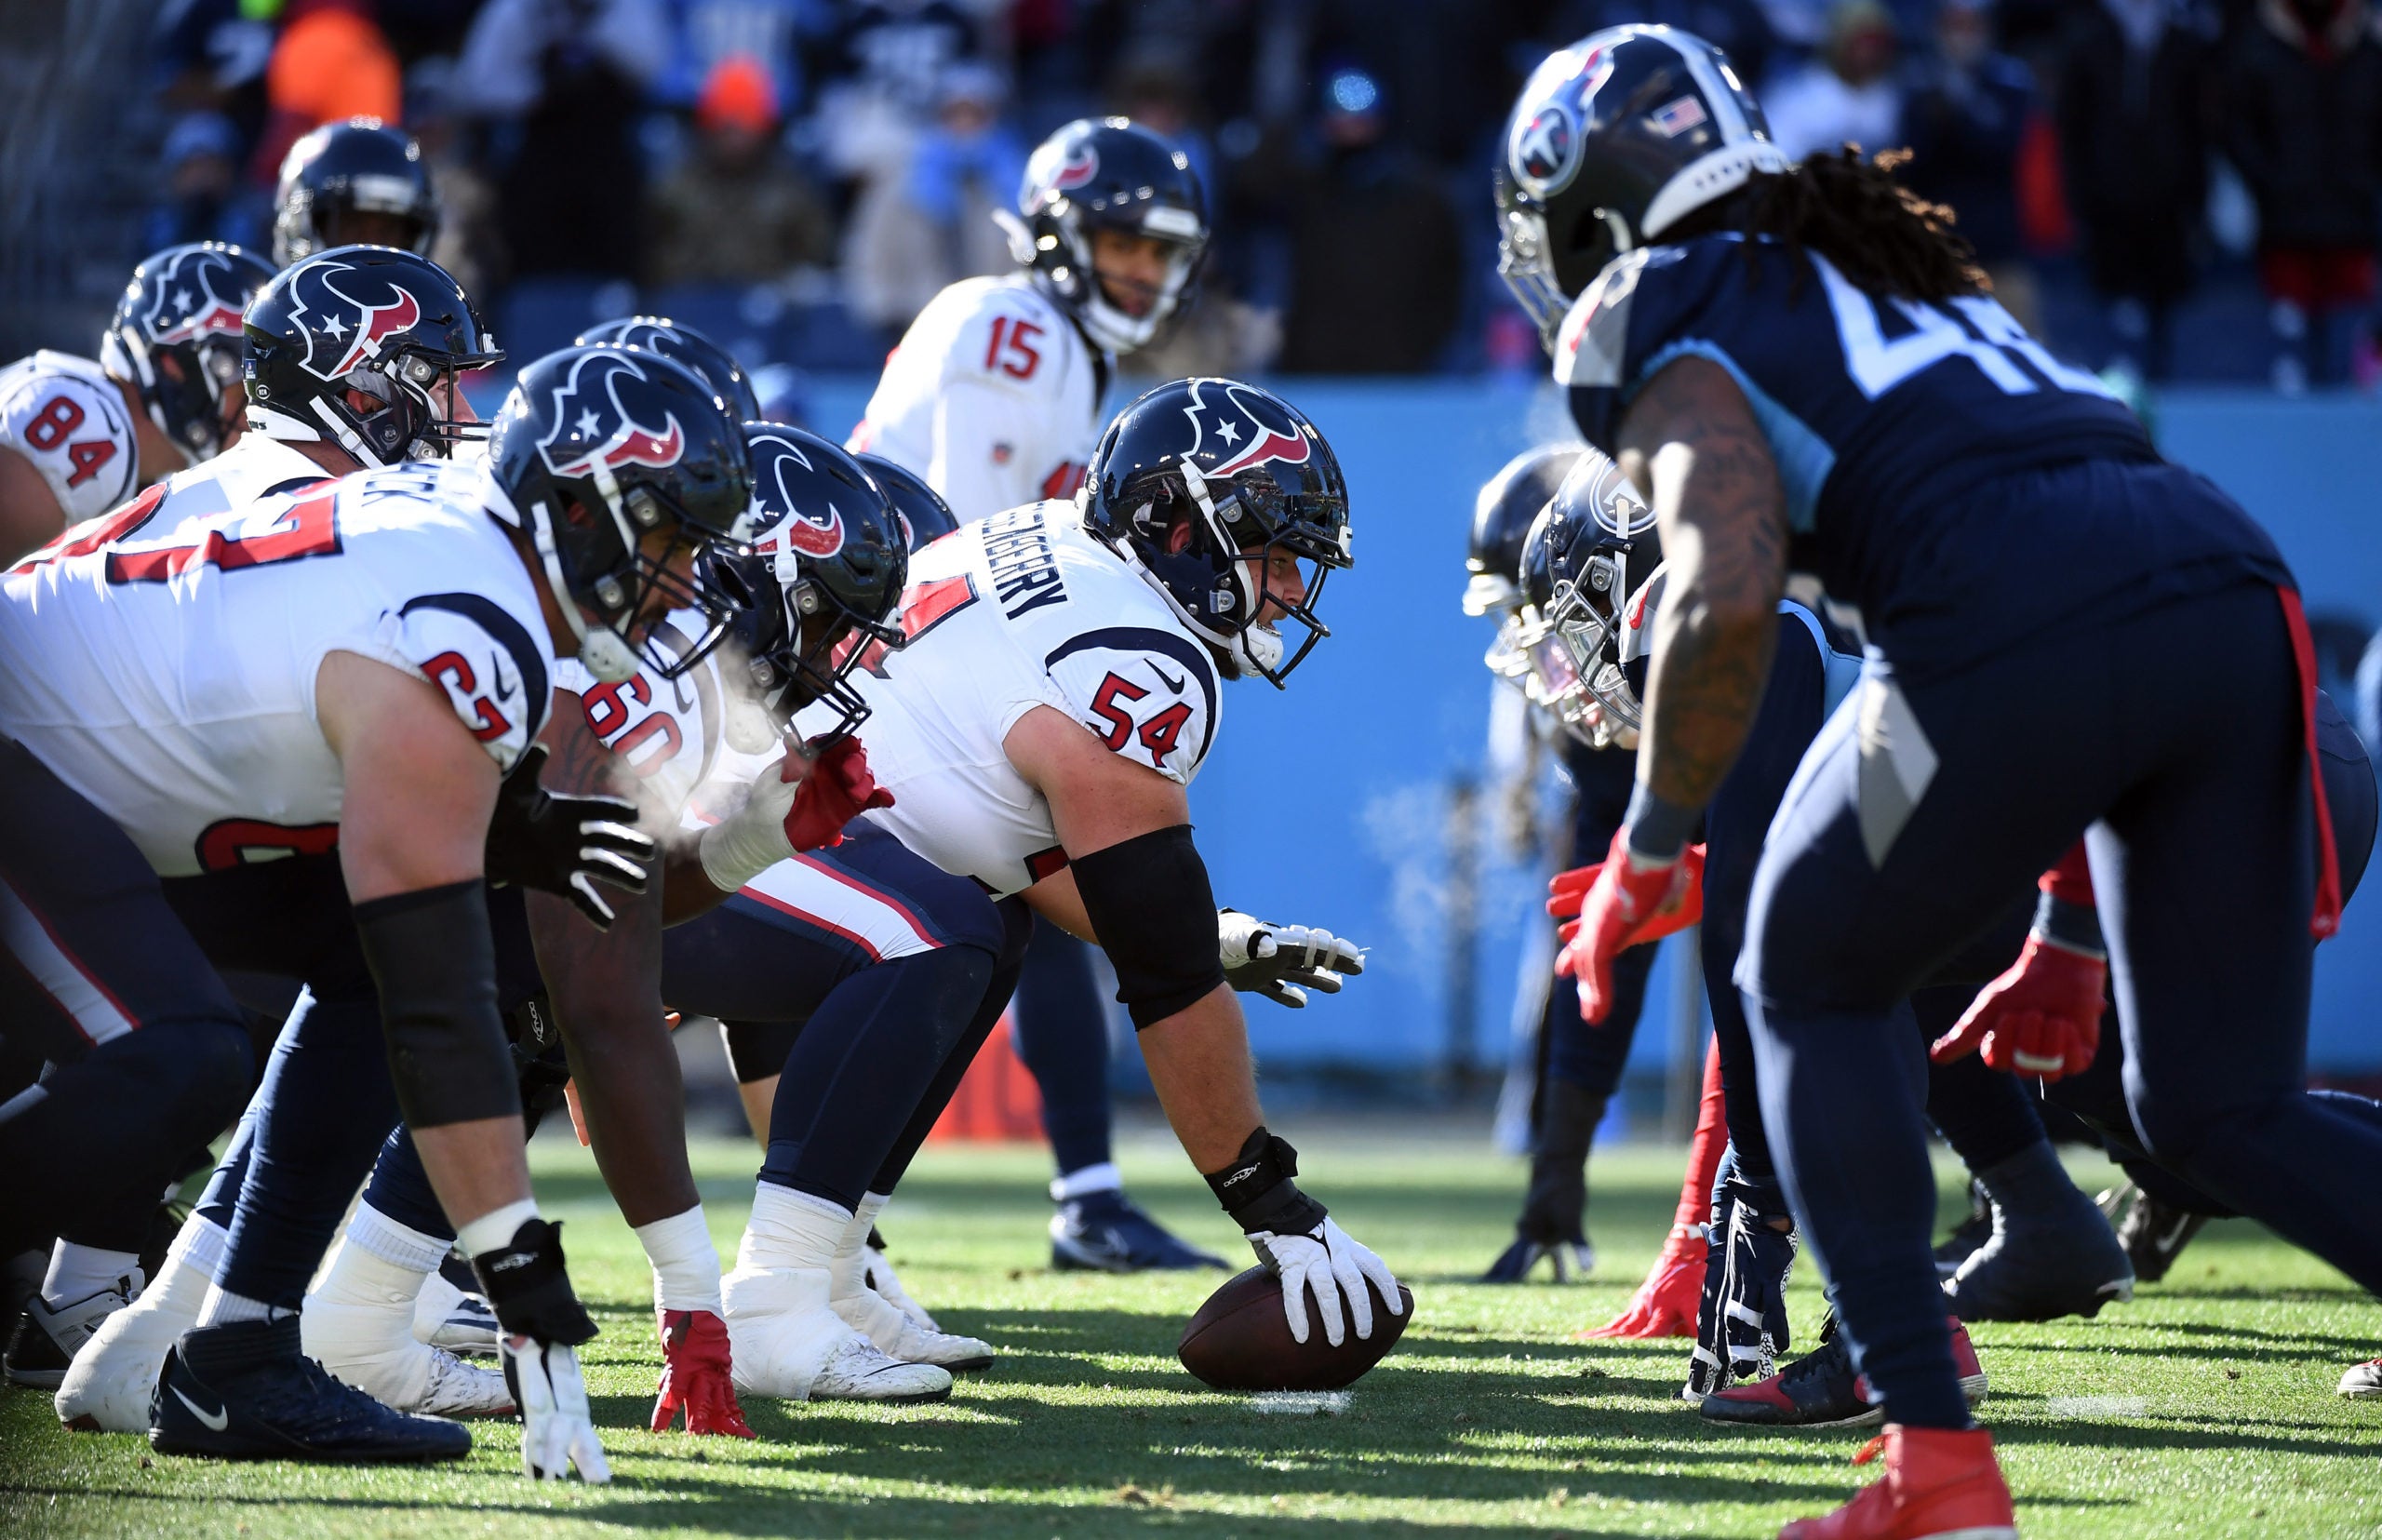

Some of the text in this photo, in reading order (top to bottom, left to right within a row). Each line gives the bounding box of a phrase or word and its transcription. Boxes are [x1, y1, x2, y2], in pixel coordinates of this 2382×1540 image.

[985, 315, 1045, 381] 15
[24, 395, 117, 489] 84
[582, 672, 683, 779] 60
[1086, 670, 1194, 769] 54
